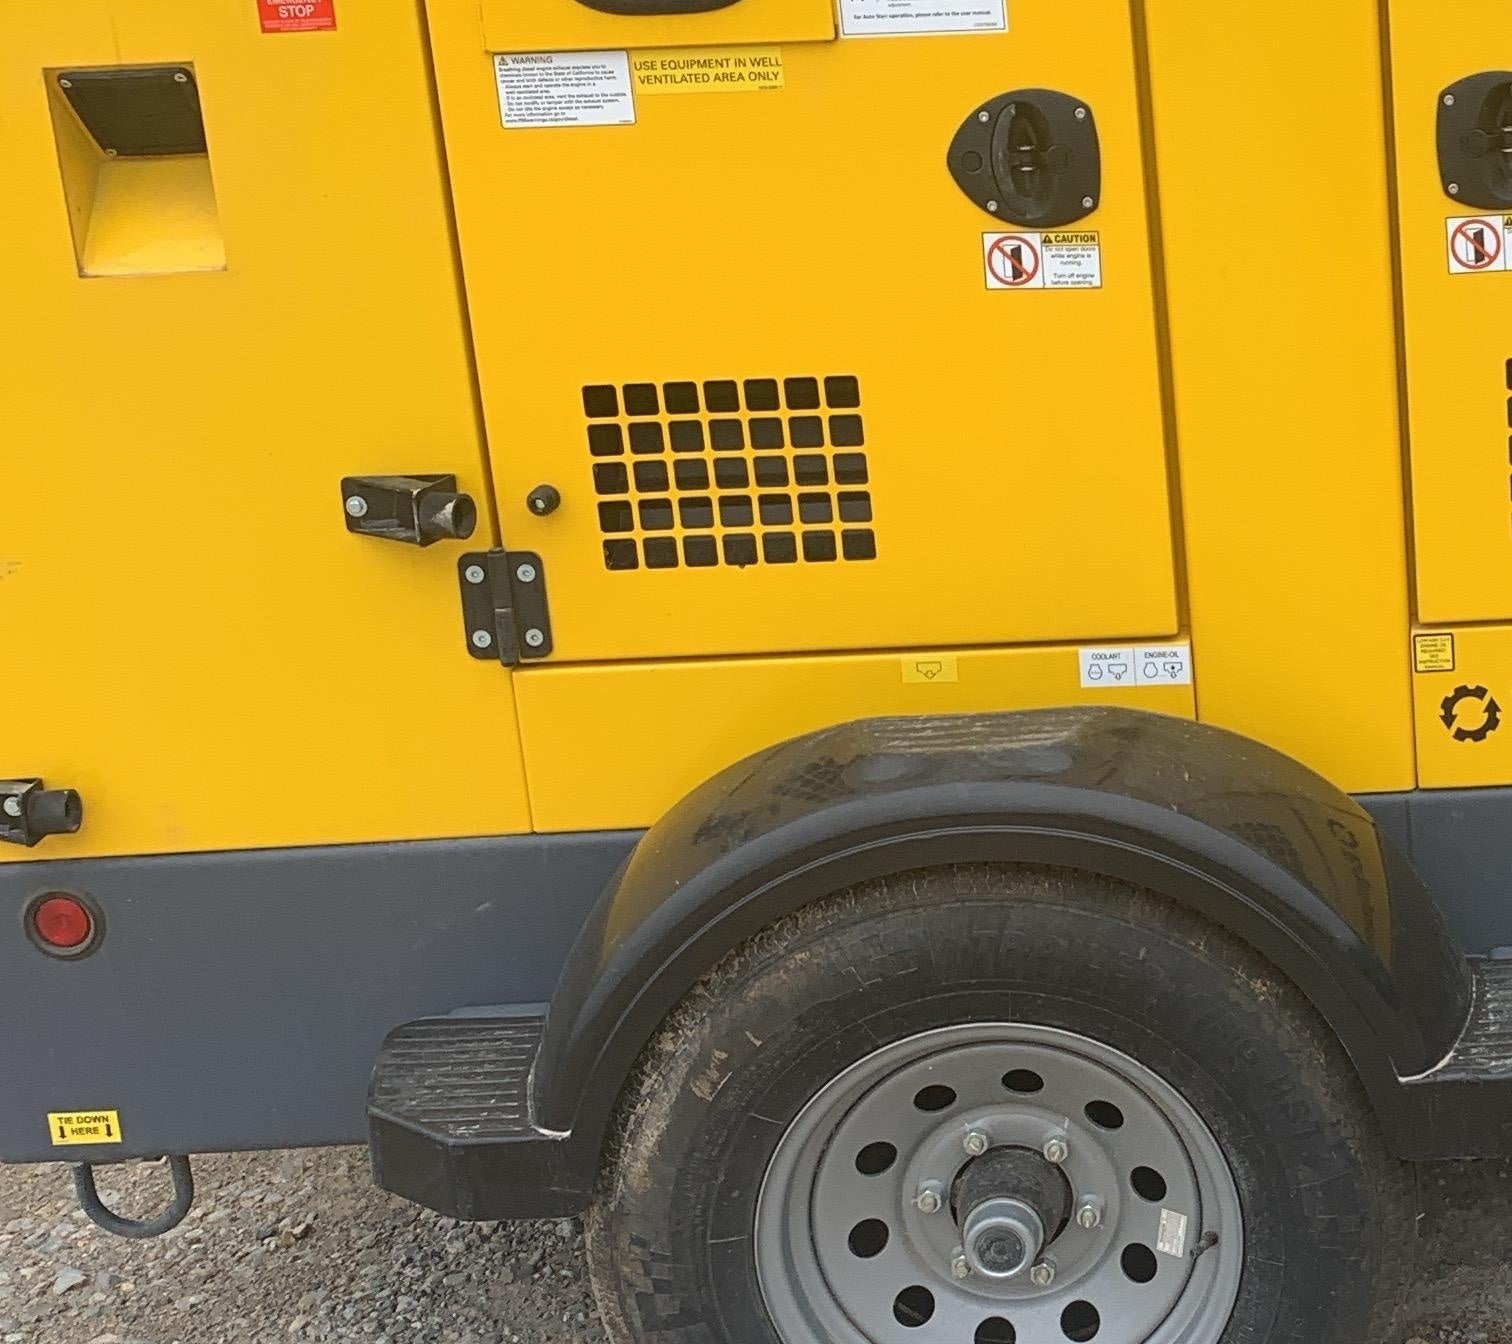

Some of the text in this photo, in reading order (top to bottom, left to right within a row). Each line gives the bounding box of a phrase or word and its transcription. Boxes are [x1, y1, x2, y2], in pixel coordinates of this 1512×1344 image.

[278, 5, 314, 18] STOP
[511, 56, 553, 64] WARNING
[634, 57, 782, 71] USE EQUIPMENT IN WELL
[638, 71, 779, 85] VENTILATED AREA ONLY
[1054, 234, 1096, 243] CAUTION
[57, 1115, 109, 1125] TIE DOWN
[71, 1126, 100, 1135] HERE
